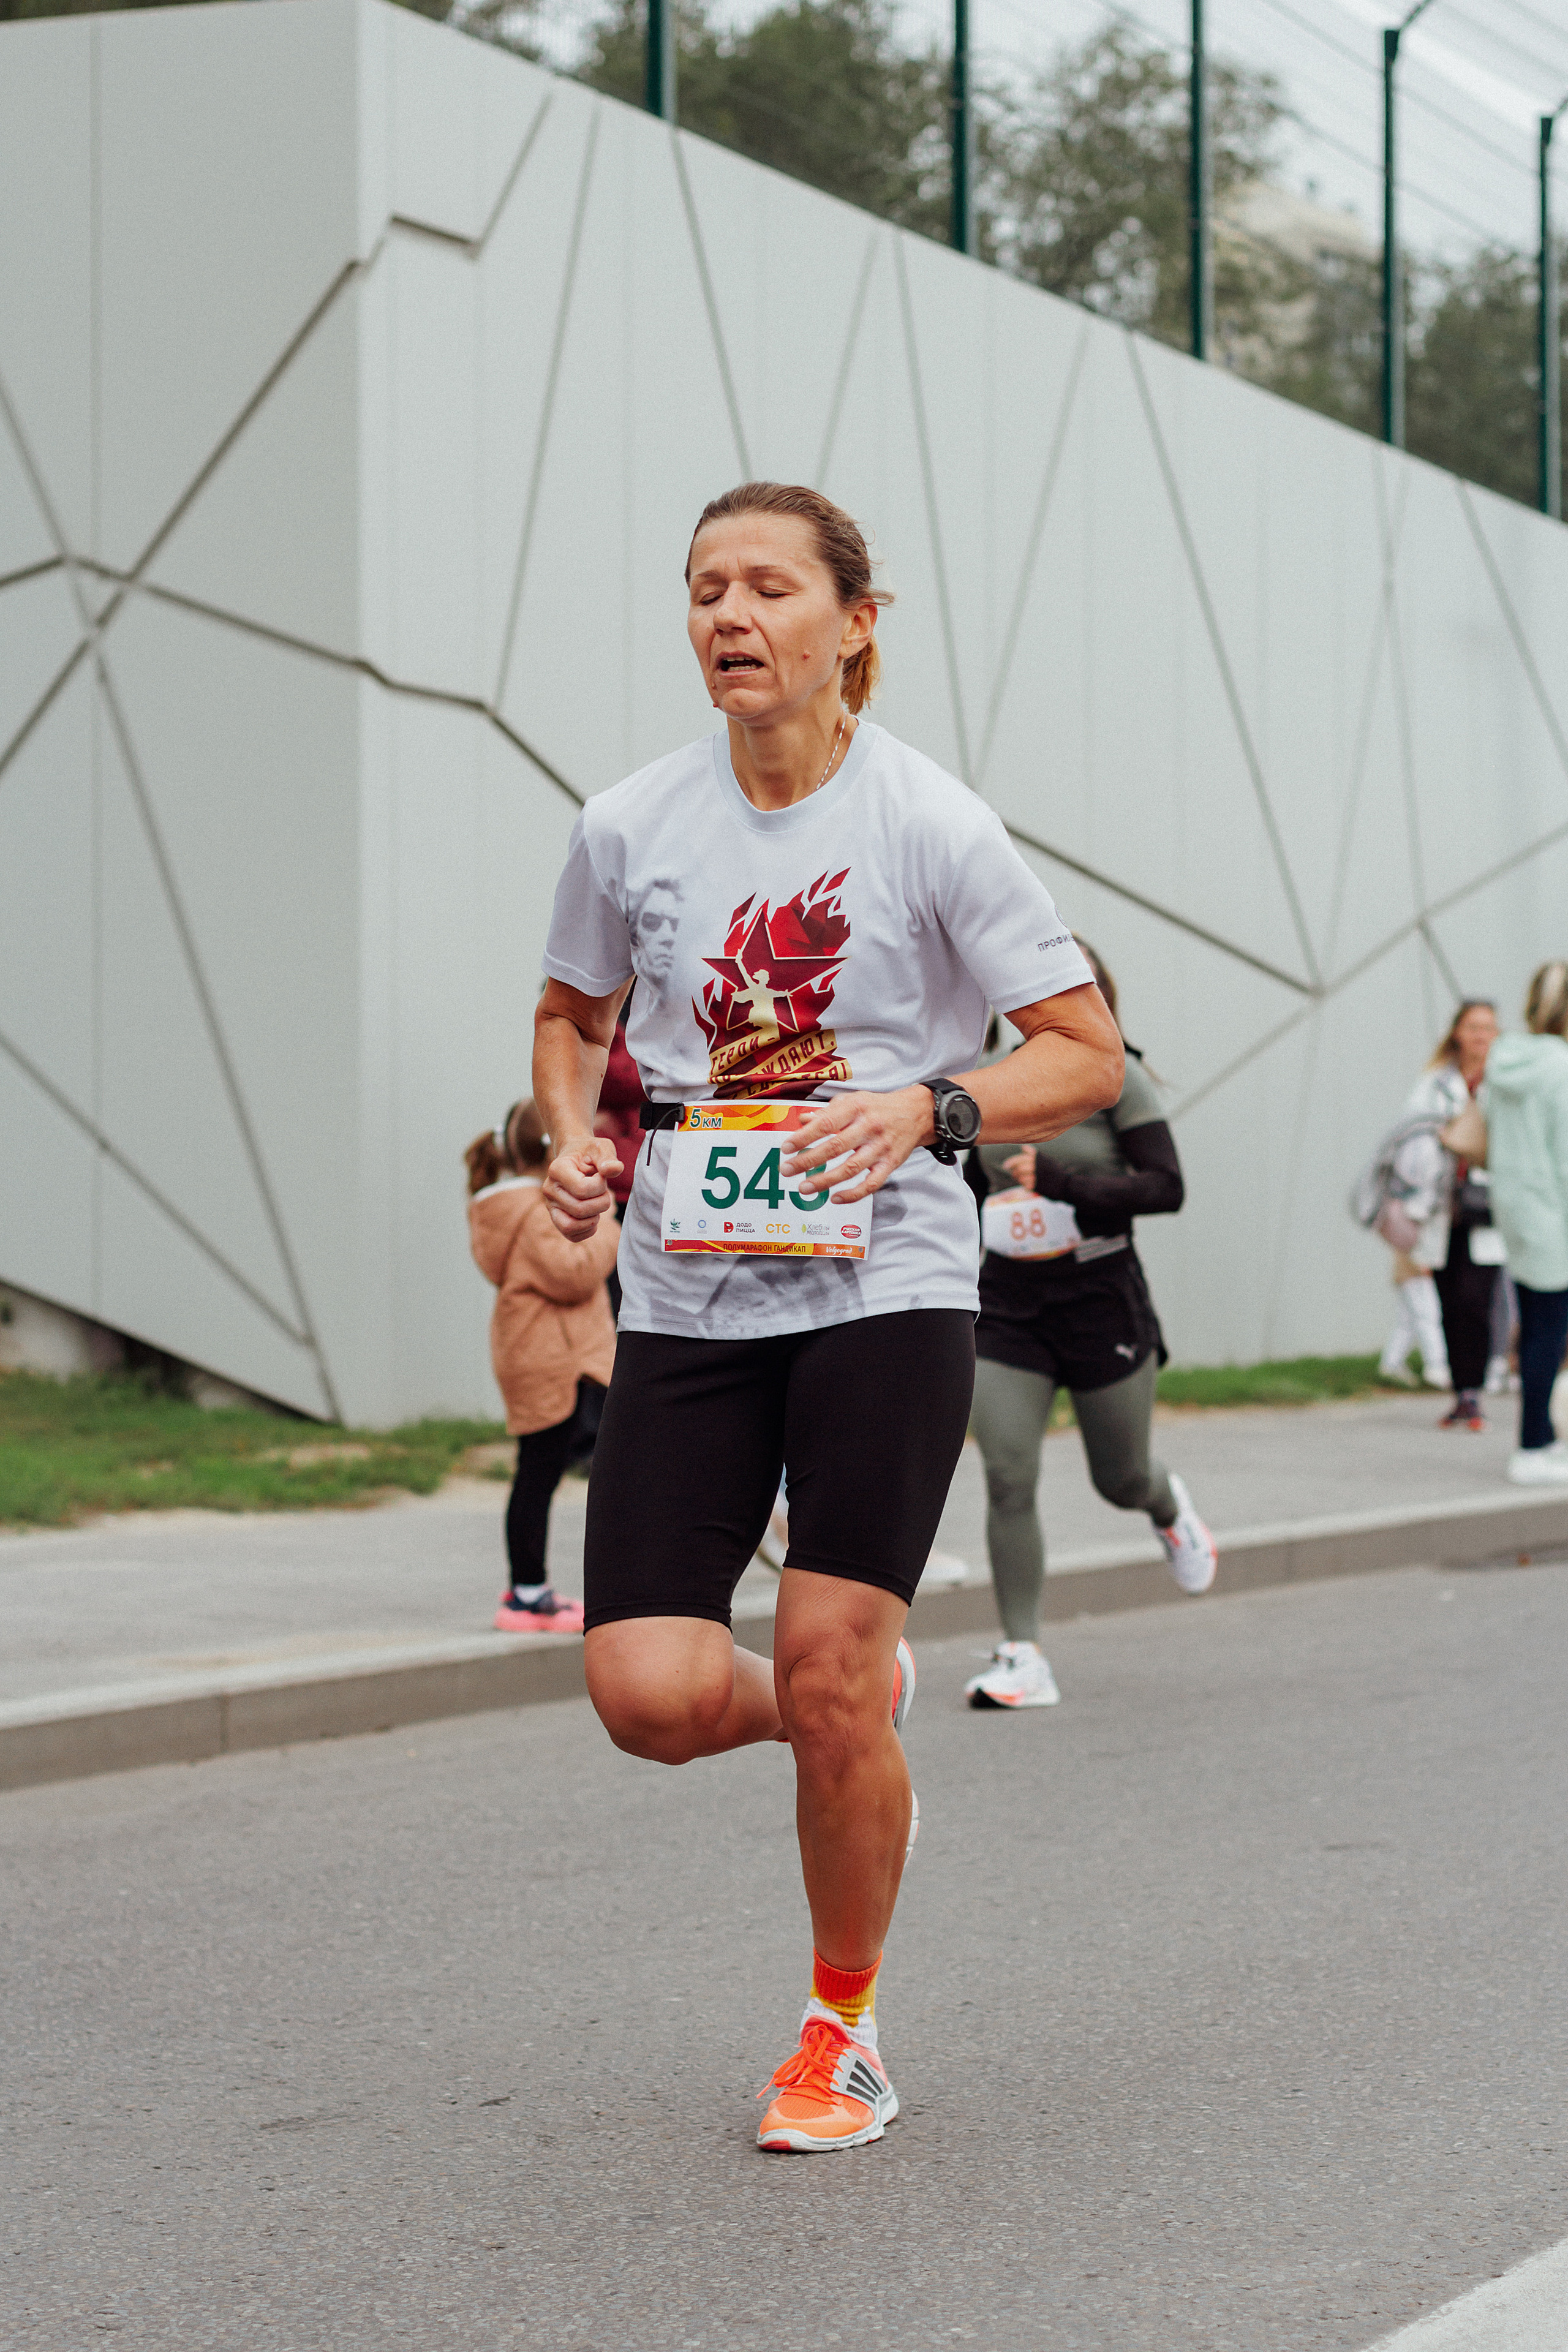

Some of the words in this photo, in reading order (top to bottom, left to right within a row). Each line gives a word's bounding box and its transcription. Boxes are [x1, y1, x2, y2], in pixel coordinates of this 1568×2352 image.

[1038, 933, 1074, 951] ПРОФИ
[710, 1036, 759, 1074] ГЕРОИ
[690, 1109, 701, 1128] 5
[701, 1147, 829, 1212] 543
[766, 1223, 791, 1234] СТС
[1011, 1208, 1046, 1240] 88
[723, 1243, 772, 1252] ПОЛУМАРАФОН
[774, 1245, 806, 1253] ГАНДИКАП
[826, 1246, 853, 1255] Volgograd
